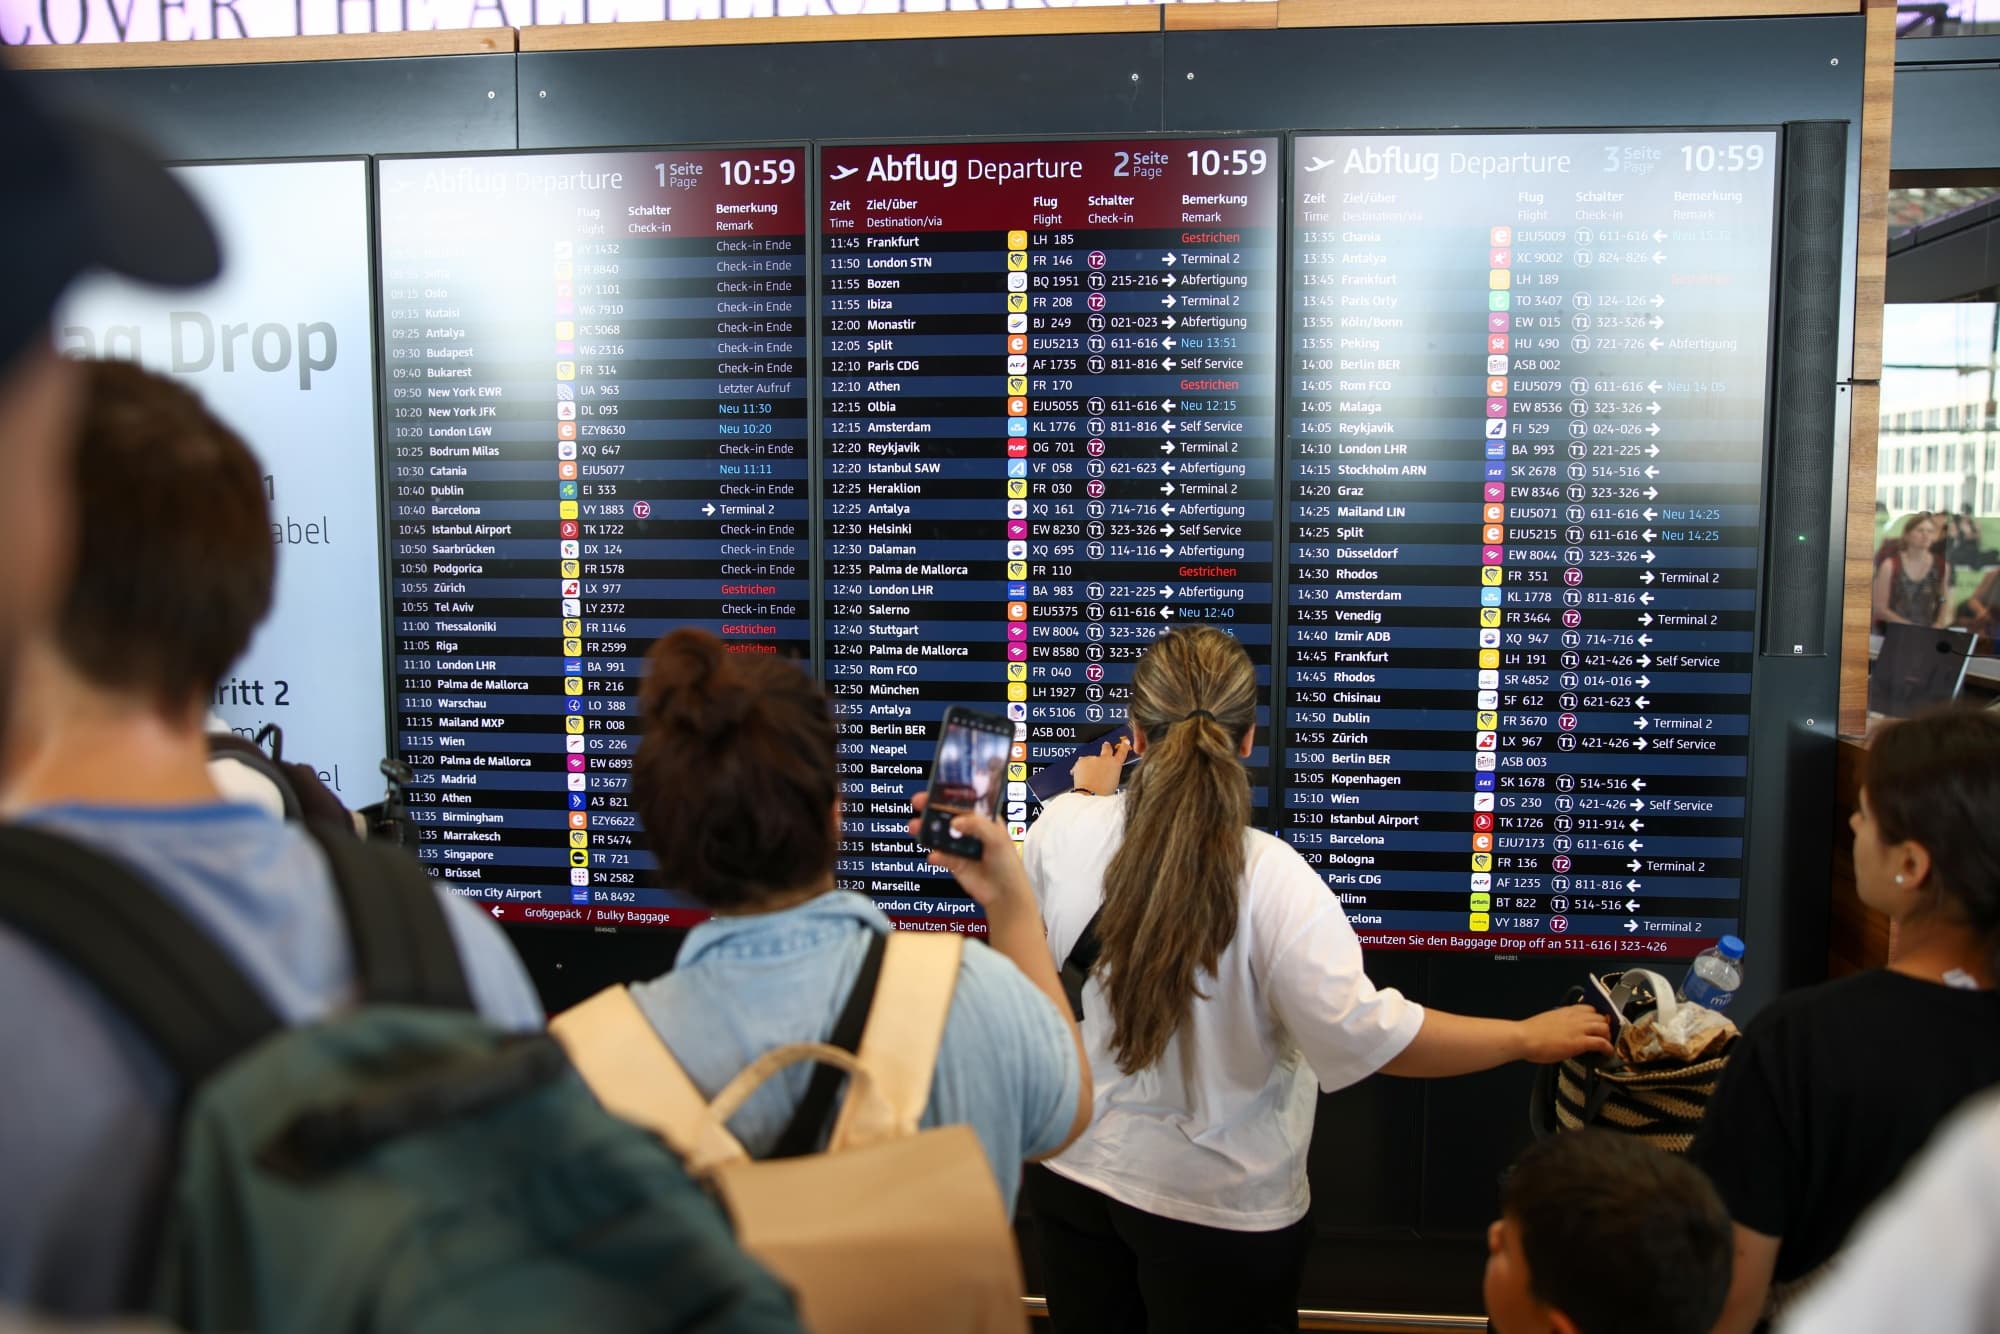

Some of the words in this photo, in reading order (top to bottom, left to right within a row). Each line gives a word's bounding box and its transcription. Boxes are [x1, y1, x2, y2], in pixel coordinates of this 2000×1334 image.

[1114, 152, 1129, 176] 2
[1134, 151, 1168, 164] Seite
[1187, 149, 1267, 176] 10:59
[1344, 147, 1439, 180] Abflug
[1450, 152, 1571, 175] Departure
[1603, 146, 1620, 172] 3
[1624, 146, 1661, 160] Seite
[1681, 145, 1764, 172] 10:59
[655, 164, 664, 187] 1
[670, 162, 702, 175] Seite
[720, 159, 795, 185] 10:59
[867, 153, 957, 187] Abflug
[969, 158, 1082, 185] Departure
[1134, 166, 1162, 179] Page
[670, 177, 696, 190] Page
[830, 200, 851, 210] Zeit
[867, 199, 917, 211] Ziel/über
[1034, 196, 1057, 209] Flug
[1089, 195, 1134, 205] Schalter
[1183, 194, 1247, 206] Bemerkung
[1303, 193, 1326, 204] Zeit
[1518, 192, 1544, 205] Flug
[1576, 191, 1624, 202] Schalter
[1674, 190, 1742, 204] Bemerkung
[628, 205, 671, 216] Schalter
[716, 203, 777, 215] Bemerkung
[628, 222, 671, 232] Check-in
[717, 220, 753, 230] Remark
[830, 218, 854, 228] Time
[867, 216, 942, 227] Destination/via
[1034, 214, 1062, 227] Flight
[1089, 213, 1133, 223] Check-in
[1183, 212, 1221, 222] Remark
[831, 238, 859, 248] 11:45
[867, 236, 919, 247] Frankfurt
[1034, 235, 1047, 244] LH
[1055, 234, 1073, 244] 185
[1182, 232, 1240, 244] Gestrichen
[831, 259, 859, 268] 11:50
[868, 257, 907, 268] London
[911, 258, 931, 267] STN
[1034, 256, 1046, 265] FR
[1053, 256, 1072, 265] 146
[1182, 253, 1230, 263] Terminal
[1233, 254, 1239, 263] 2
[170, 312, 338, 391] Drop
[832, 341, 860, 350] 12:05
[868, 340, 893, 353] Split
[1034, 339, 1078, 349] EJU5213
[1111, 338, 1158, 348] 611-616
[1182, 338, 1202, 347] Neu
[1208, 338, 1238, 347] 13:51
[393, 369, 421, 378] 09:40
[428, 368, 472, 377] Bukarest
[580, 365, 592, 375] FR
[596, 365, 616, 375] 314
[718, 362, 763, 373] Check-in
[767, 363, 792, 372] Ende
[1302, 360, 1332, 371] 14:00
[1341, 358, 1375, 369] Berlin
[1378, 360, 1400, 369] BER
[1514, 360, 1536, 369] ASB
[1540, 360, 1560, 370] 002
[396, 408, 422, 417] 10:20
[429, 408, 451, 416] New
[453, 406, 476, 416] York
[479, 407, 496, 416] JFK
[581, 405, 593, 415] DL
[599, 405, 618, 414] 093
[719, 404, 739, 413] Neu
[743, 404, 771, 413] 11:30
[832, 423, 860, 432] 12:15
[868, 422, 930, 432] Amsterdam
[1034, 422, 1046, 431] KL
[1050, 422, 1076, 431] 1776
[1111, 422, 1157, 431] 811-816
[1181, 420, 1201, 431] Self
[1204, 421, 1243, 431] Service
[399, 506, 425, 515] 10:40
[432, 505, 480, 514] Barcelona
[583, 505, 596, 514] VY
[600, 505, 624, 514] 1883
[720, 504, 765, 514] Terminal
[769, 505, 774, 514] 2
[1300, 507, 1329, 516] 14:25
[1338, 506, 1381, 516] Mailand
[1385, 507, 1405, 517] LIN
[1511, 508, 1557, 518] EJU5071
[1591, 509, 1638, 519] 611-616
[1663, 509, 1684, 519] Neu
[1690, 510, 1720, 519] 14:25
[1299, 569, 1329, 578] 14:30
[1337, 569, 1378, 579] Rhodos
[1509, 571, 1521, 580] FR
[1528, 571, 1547, 581] 351
[1660, 572, 1708, 583] Terminal
[1713, 574, 1719, 583] 2
[401, 584, 427, 592] 10:55
[434, 583, 465, 592] Zürich
[586, 584, 597, 593] LX
[603, 584, 621, 593] 977
[722, 584, 775, 594] Gestrichen
[834, 665, 862, 674] 12:50
[870, 665, 893, 674] Rom
[897, 665, 917, 675] FCO
[1033, 667, 1045, 676] FR
[1051, 668, 1071, 677] 040
[275, 681, 289, 705] 2
[408, 736, 433, 745] 11:15
[440, 736, 464, 746] Wien
[590, 740, 603, 748] OS
[609, 740, 627, 749] 226
[410, 793, 436, 801] 11:30
[442, 793, 471, 802] Athen
[591, 797, 604, 806] A3
[610, 798, 628, 806] 821
[1294, 794, 1323, 803] 15:10
[1331, 794, 1359, 803] Wien
[1500, 798, 1515, 807] OS
[1521, 798, 1542, 807] 230
[1580, 799, 1626, 809] 421-426
[1650, 800, 1671, 810] Self
[1674, 801, 1712, 810] Service
[525, 908, 581, 920] Großgepäck
[597, 910, 624, 922] Bulky
[628, 912, 669, 924] Baggage
[1357, 934, 1405, 947] benutzen
[1409, 936, 1424, 945] Sie
[1427, 936, 1447, 945] den
[1451, 937, 1497, 949] Baggage
[1500, 938, 1526, 950] Drop
[1529, 938, 1546, 948] off
[1565, 940, 1611, 950] 511-616
[1620, 941, 1667, 951] 323-426
